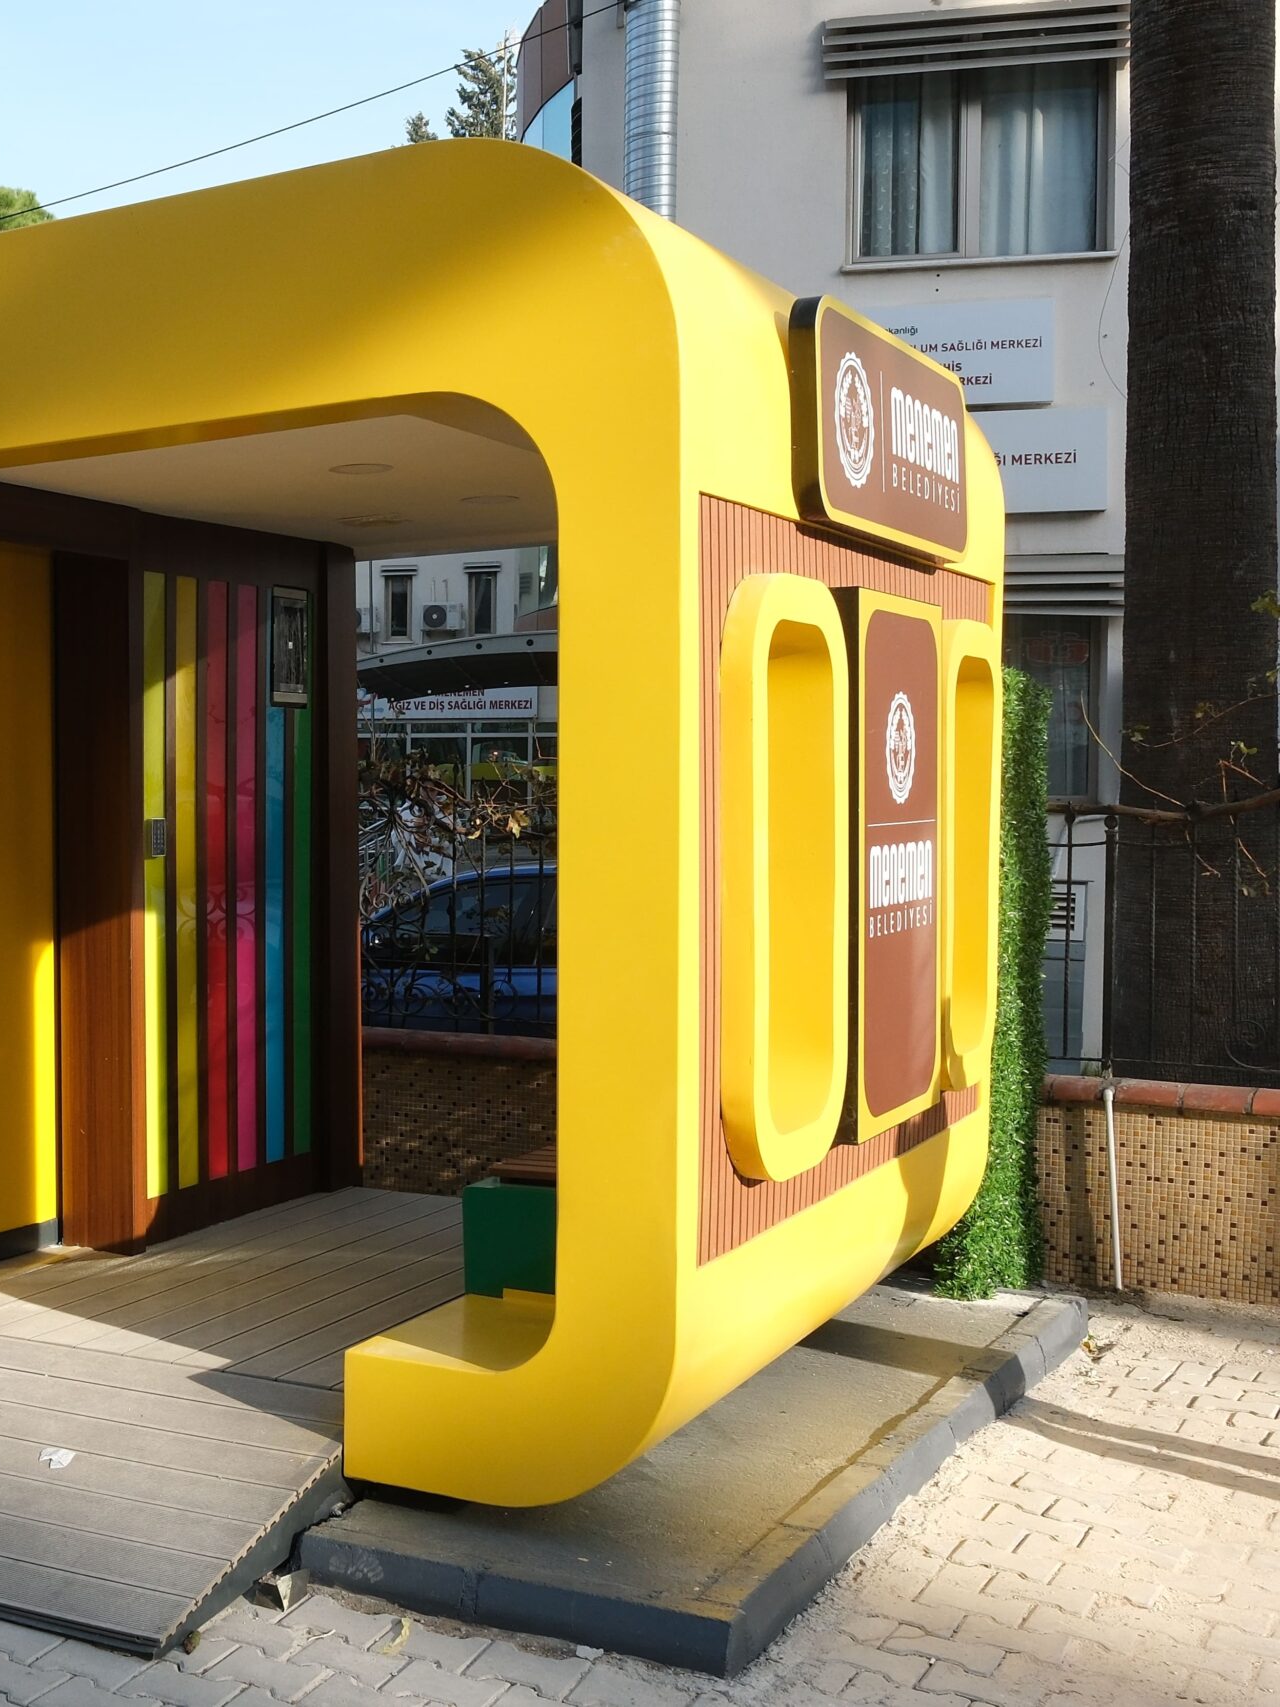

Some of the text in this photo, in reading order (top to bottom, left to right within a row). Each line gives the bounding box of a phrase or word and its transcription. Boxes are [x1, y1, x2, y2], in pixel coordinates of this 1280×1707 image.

[941, 339, 987, 352] SAĞLIĞI
[990, 336, 1043, 350] MERKEZİ
[958, 373, 993, 386] RKEZİ
[1011, 449, 1077, 466] MERKEZİ
[891, 463, 960, 514] BELEDİYESİ
[414, 700, 426, 710] VE
[428, 698, 445, 713] DİŞ
[447, 698, 487, 710] SAĞLIĞI
[489, 697, 533, 710] MERKEZİ
[869, 899, 933, 938] BELEDİYESİ
